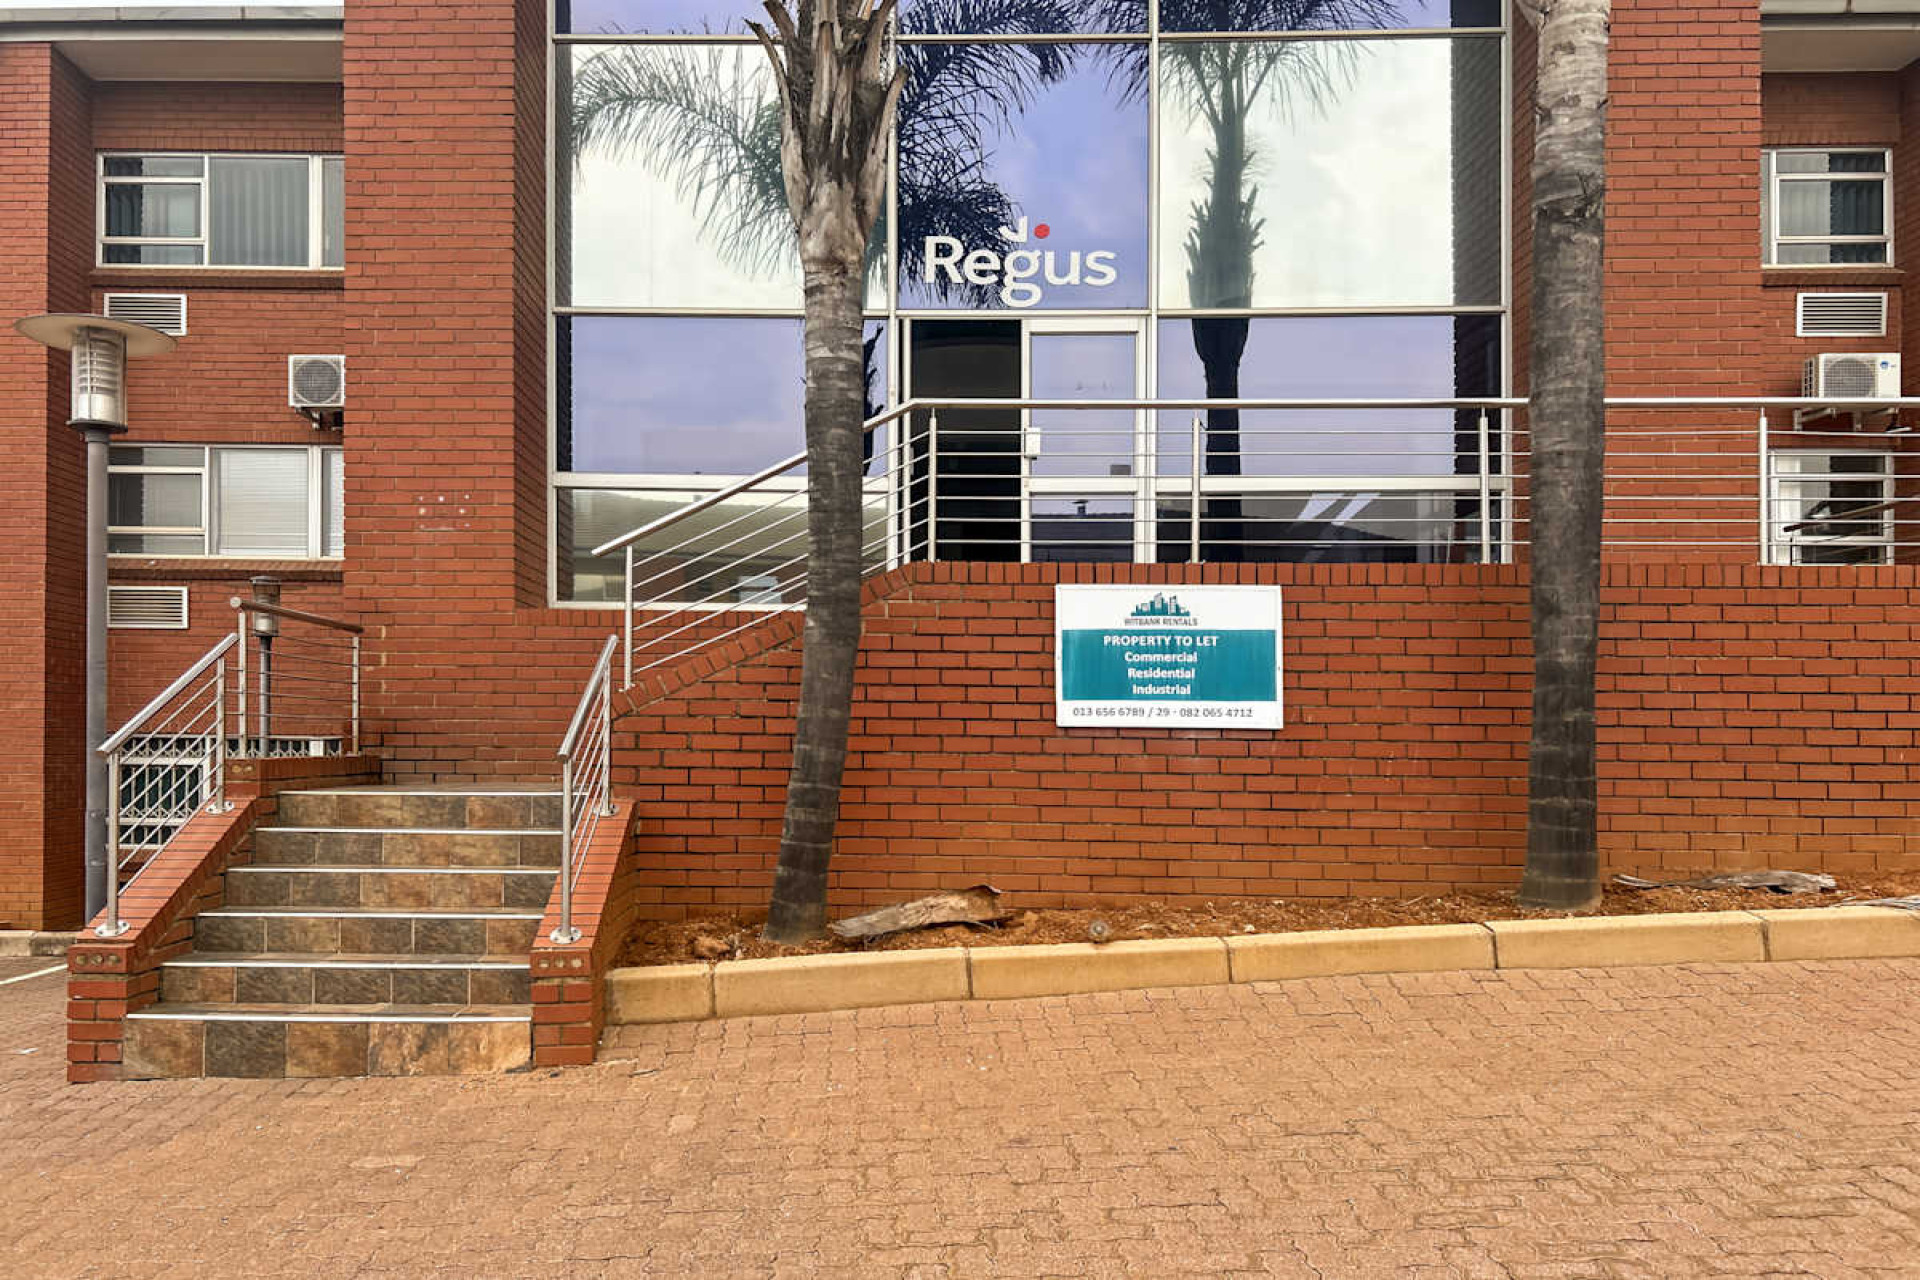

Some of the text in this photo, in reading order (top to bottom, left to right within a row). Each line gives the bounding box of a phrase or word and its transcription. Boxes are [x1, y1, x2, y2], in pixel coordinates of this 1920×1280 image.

[924, 235, 1118, 308] Regus
[1163, 618, 1198, 626] RENTALS
[1104, 635, 1218, 646] PROPERTY TO LET
[1125, 652, 1197, 662] Commercial
[1128, 668, 1195, 678] Residential
[1132, 684, 1190, 695] Industrial
[1073, 707, 1092, 716] 013
[1096, 707, 1115, 716] 656
[1156, 707, 1170, 716] 29
[1181, 708, 1199, 717] 082
[1226, 708, 1252, 717] 4712
